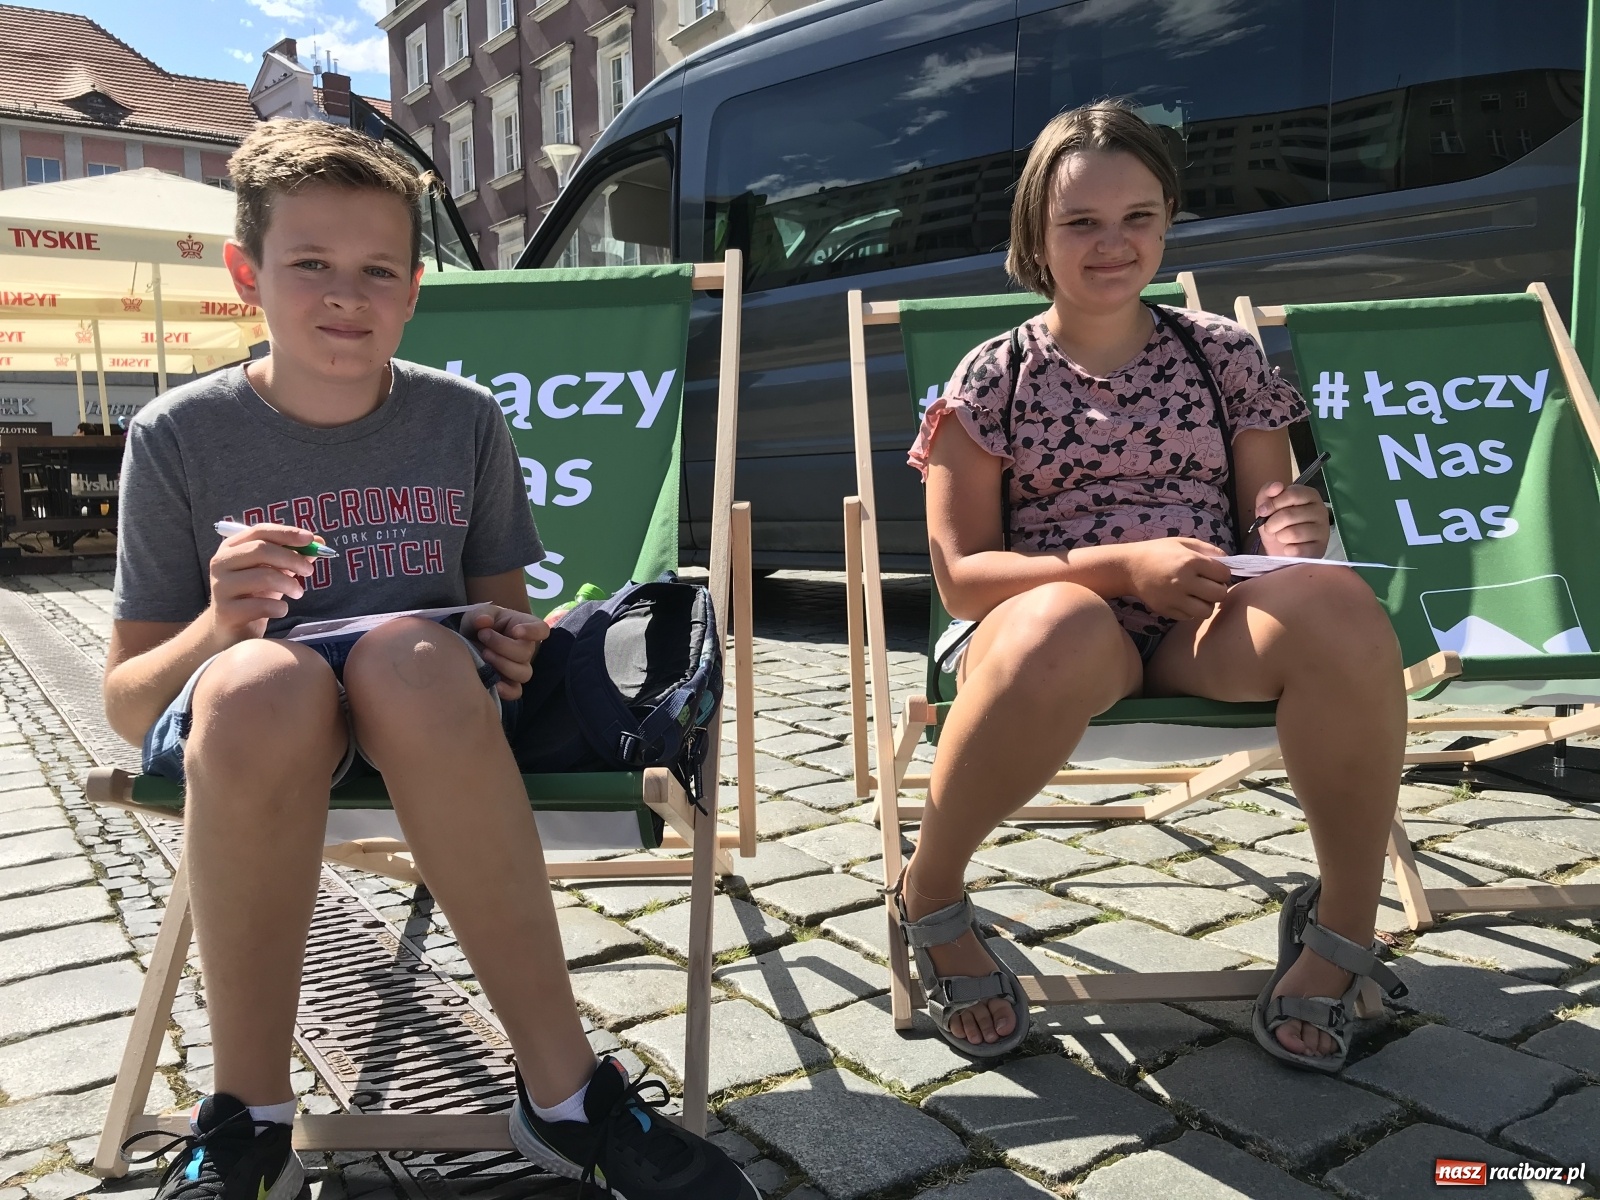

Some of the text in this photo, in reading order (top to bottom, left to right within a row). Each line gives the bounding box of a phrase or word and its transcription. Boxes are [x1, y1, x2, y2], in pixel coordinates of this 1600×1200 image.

[8, 228, 100, 250] TYSKIE
[446, 360, 676, 430] ączy
[1363, 368, 1550, 425] Łączy
[1378, 433, 1513, 481] Nas
[518, 456, 593, 507] as
[333, 527, 408, 547] YORK CITY
[1395, 498, 1519, 546] Las
[345, 539, 445, 583] FITCH
